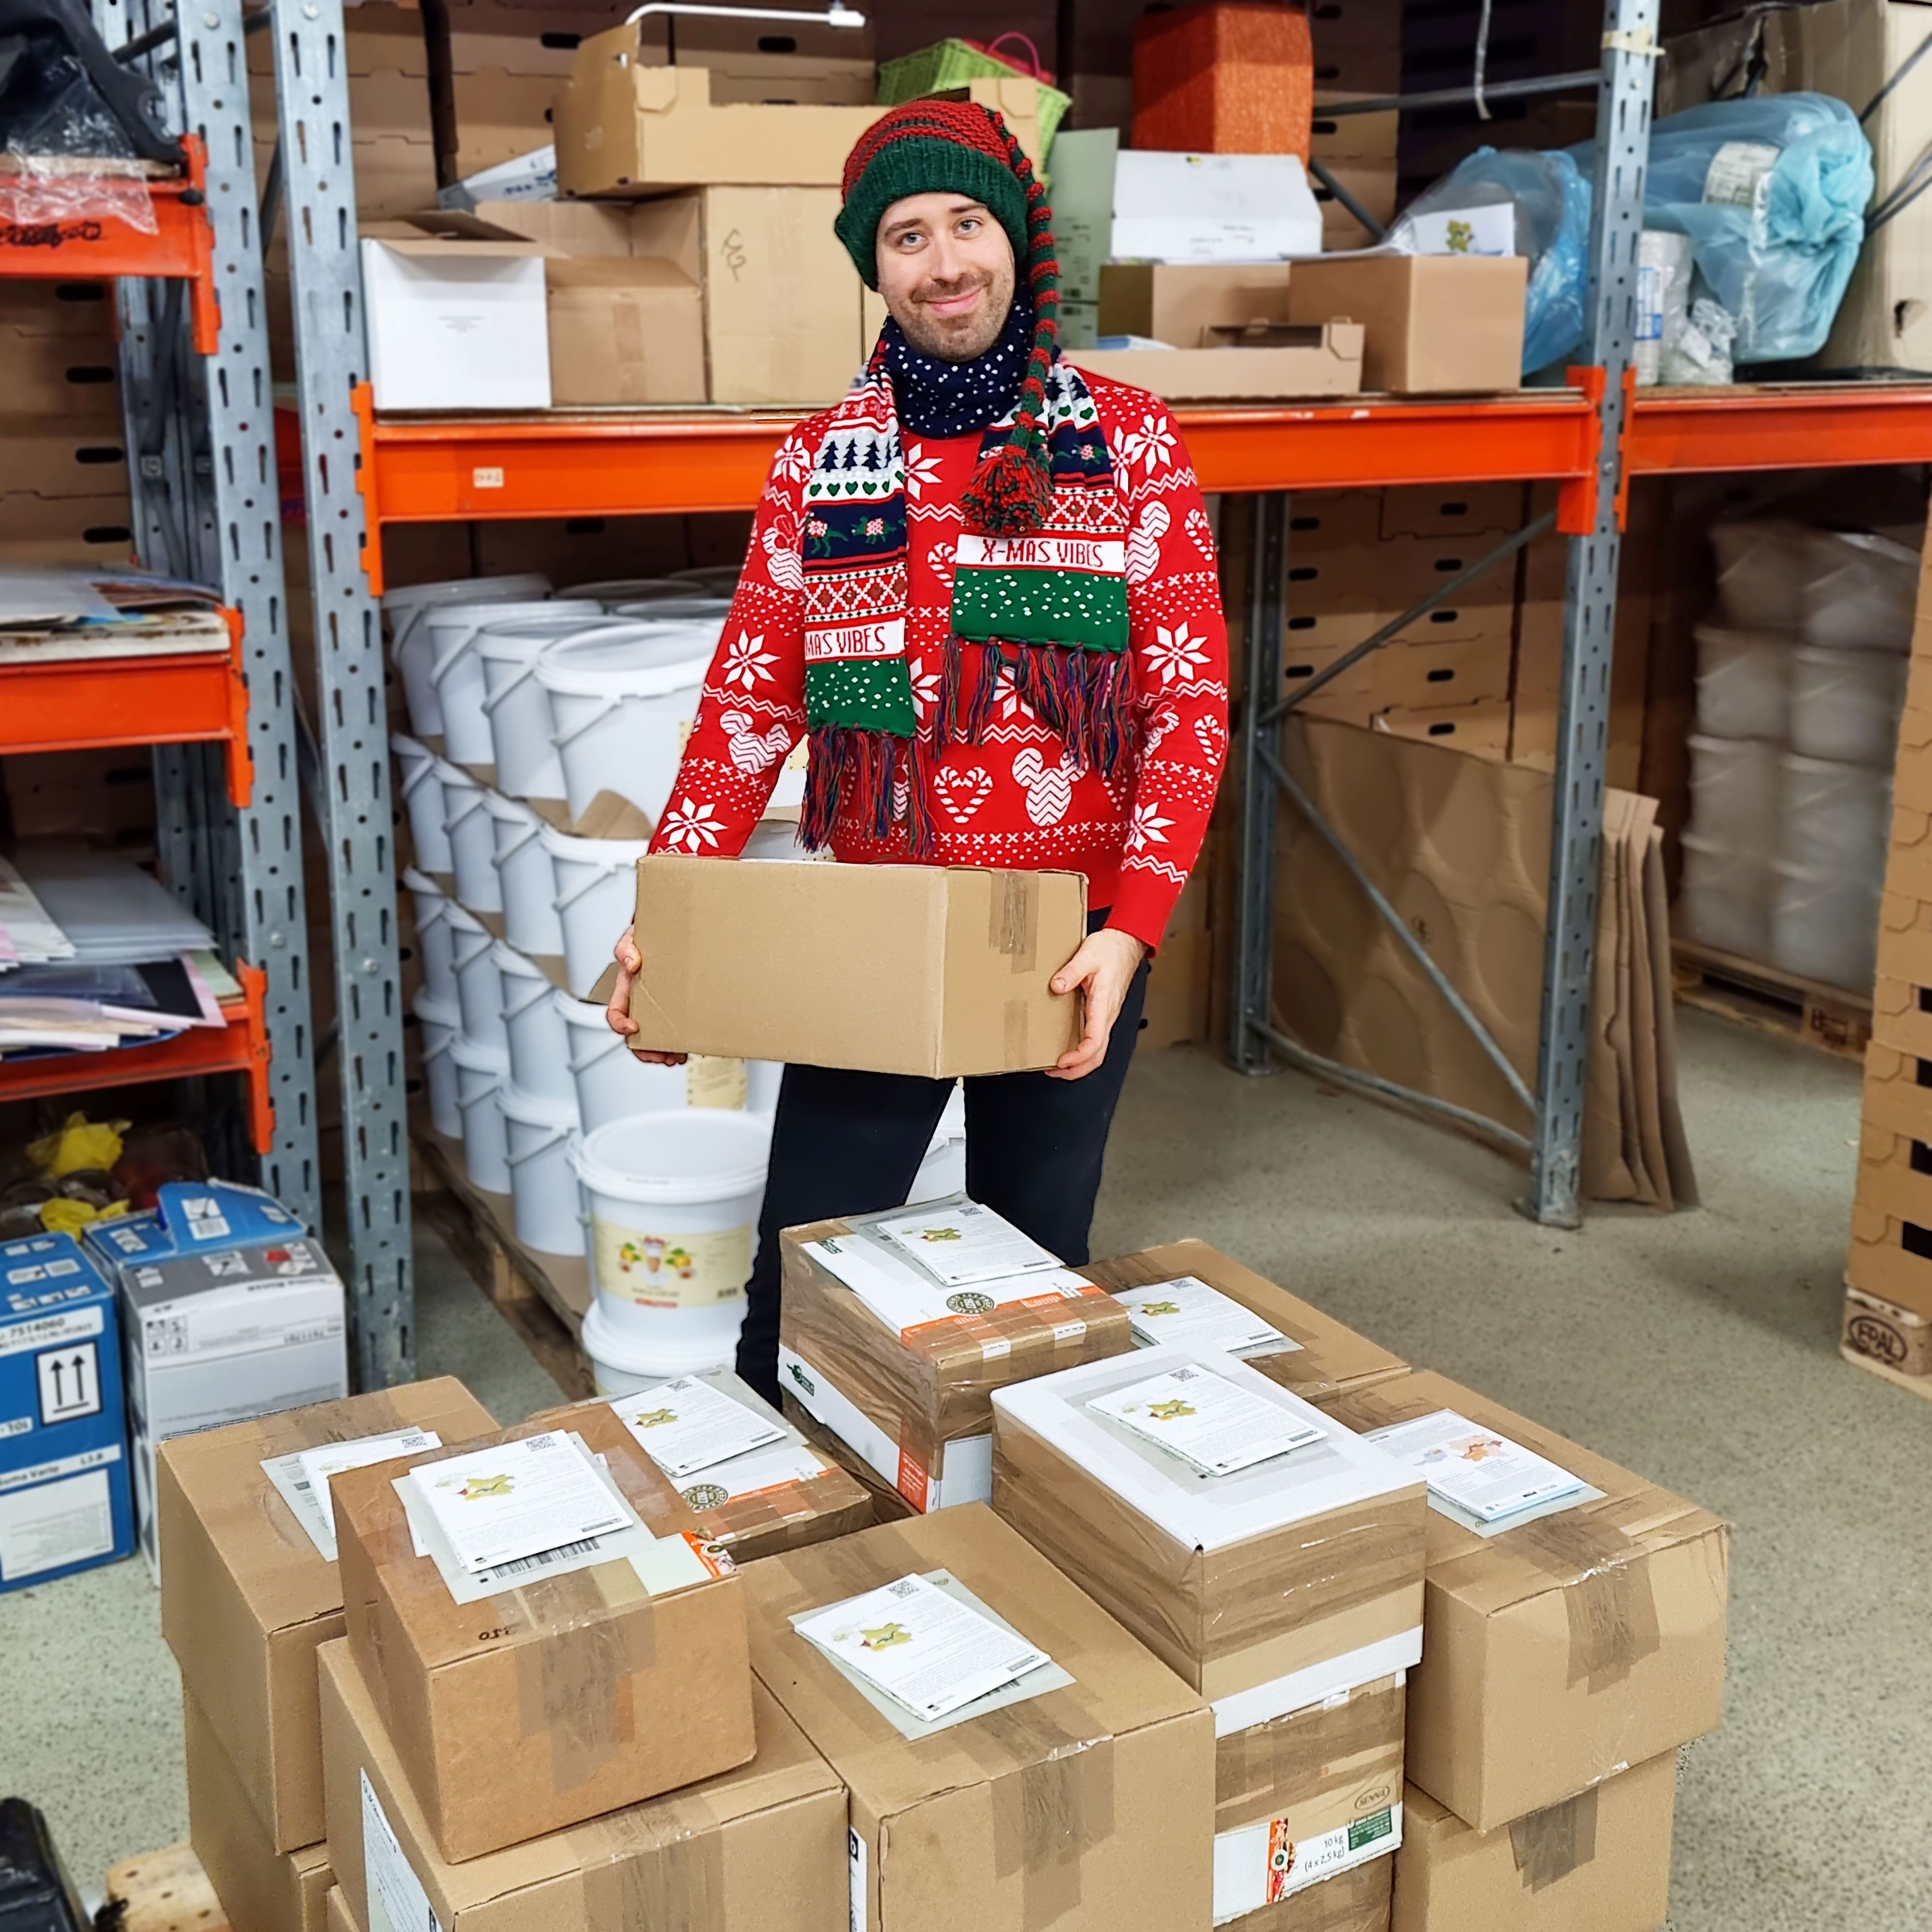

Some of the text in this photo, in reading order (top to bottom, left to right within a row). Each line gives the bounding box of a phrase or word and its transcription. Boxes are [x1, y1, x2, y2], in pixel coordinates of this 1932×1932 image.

[980, 539, 1103, 568] X-MAS VIBES
[836, 626, 885, 653] VIBES
[1858, 1322, 1900, 1358] EPAL
[1324, 1835, 1344, 1848] 10 kg
